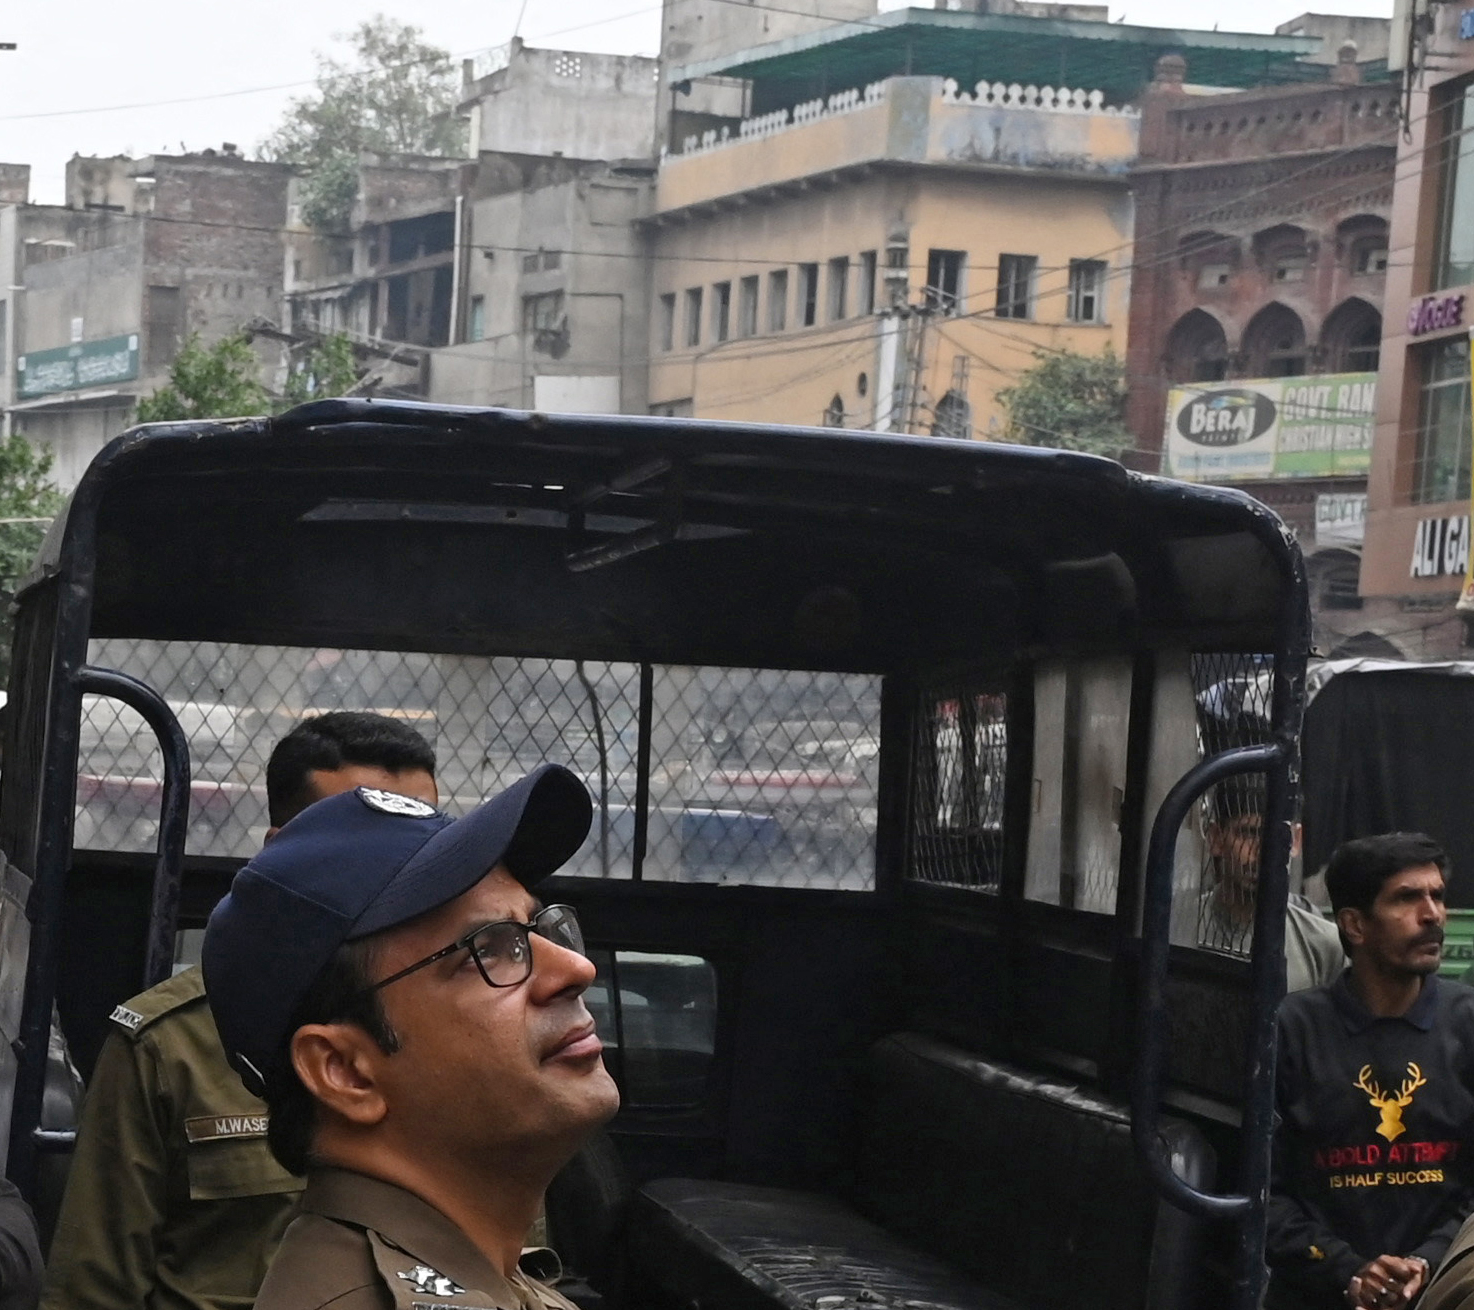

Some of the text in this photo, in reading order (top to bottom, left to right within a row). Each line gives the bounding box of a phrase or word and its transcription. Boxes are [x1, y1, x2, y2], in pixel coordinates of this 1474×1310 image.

[1189, 403, 1256, 440] BERAJ
[1329, 1169, 1444, 1188] IS HALF SUCCESS
